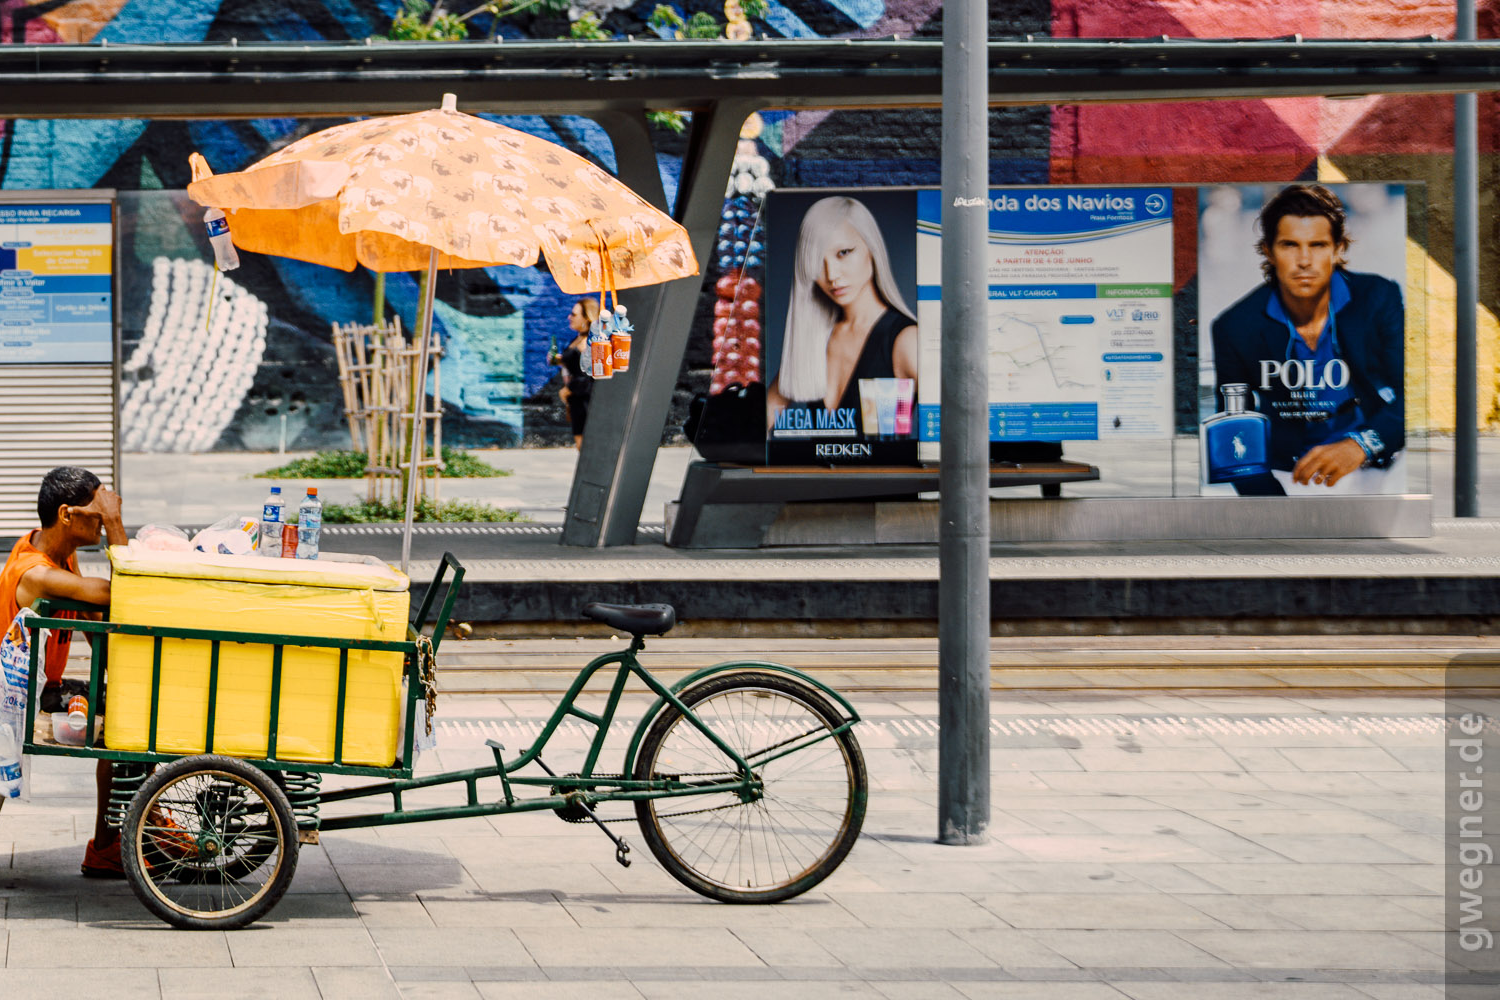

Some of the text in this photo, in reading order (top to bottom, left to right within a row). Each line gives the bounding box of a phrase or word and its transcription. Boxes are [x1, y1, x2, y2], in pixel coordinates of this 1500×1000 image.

[1025, 194, 1061, 211] dos
[1067, 194, 1134, 210] Navios
[1024, 248, 1064, 256] ATENÇÃO!
[1258, 359, 1350, 391] POLO
[774, 408, 856, 429] MEGA MASK
[815, 443, 872, 456] REDKEN
